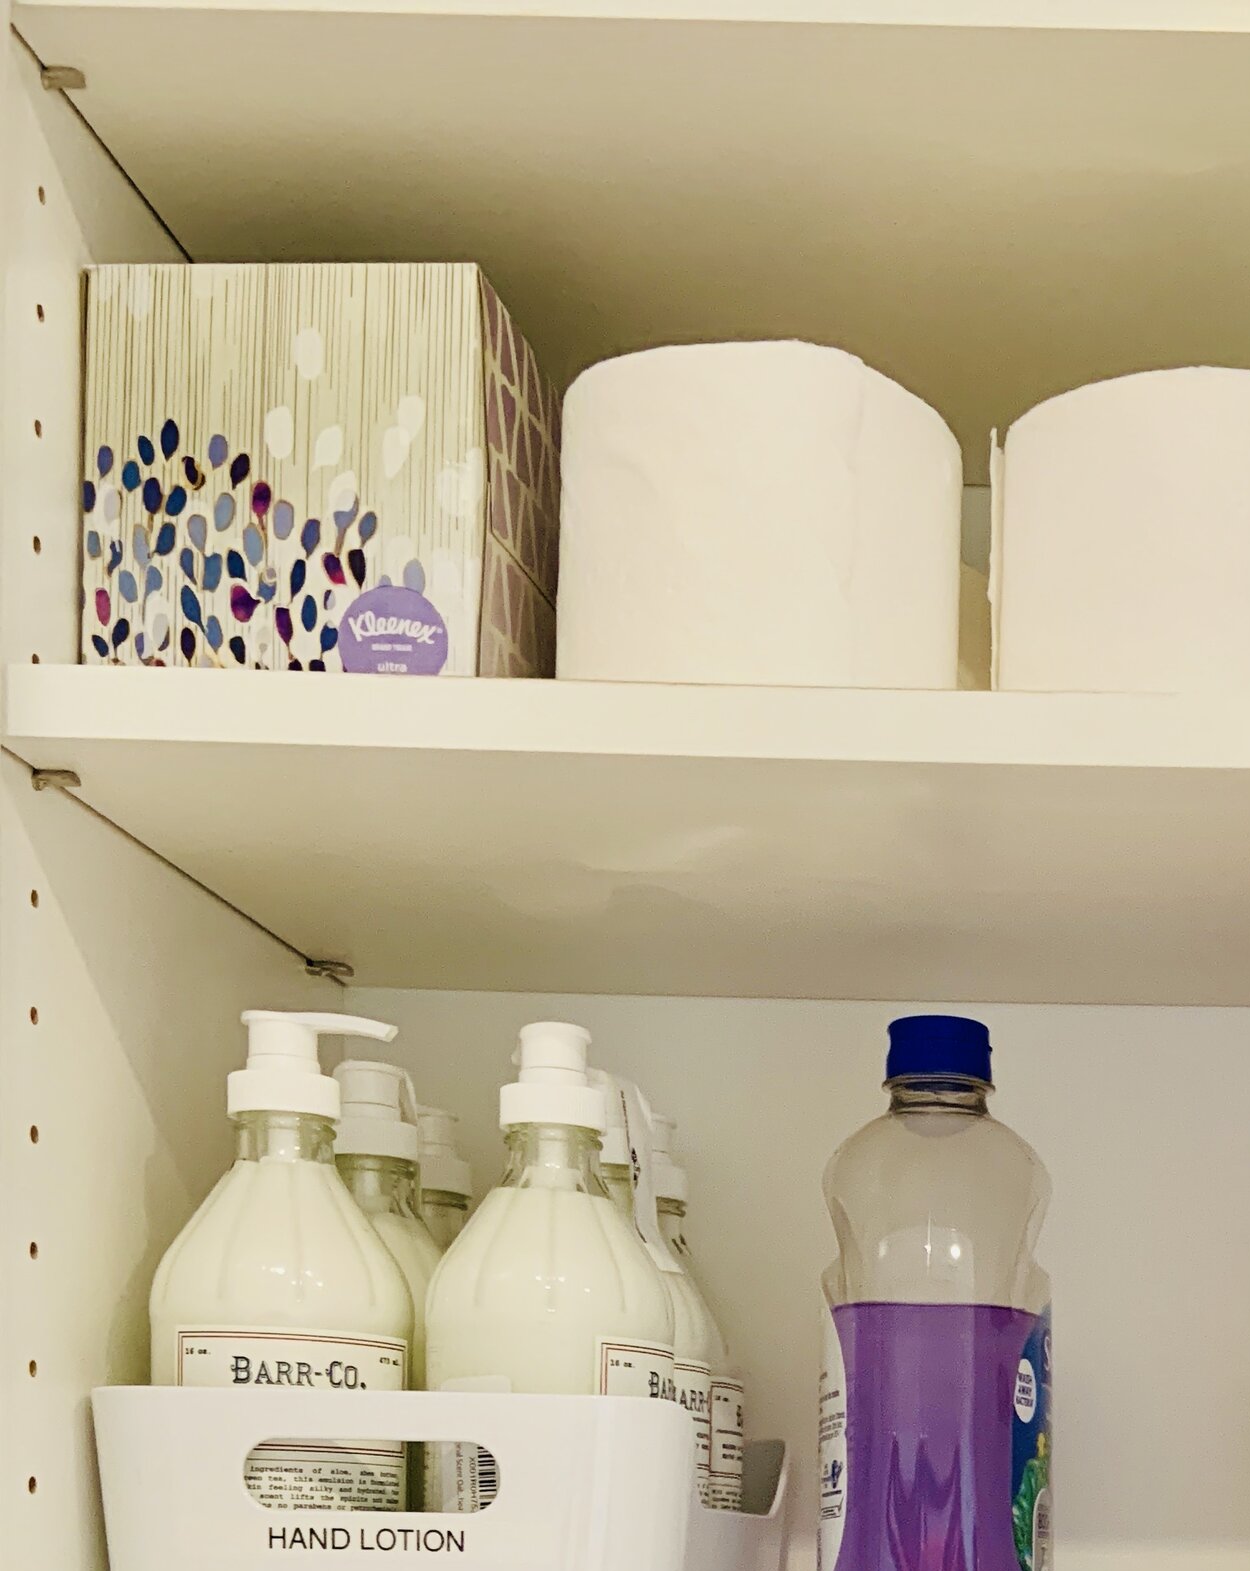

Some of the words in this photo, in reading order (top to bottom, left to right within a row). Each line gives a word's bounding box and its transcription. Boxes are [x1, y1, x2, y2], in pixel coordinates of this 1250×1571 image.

[348, 610, 435, 645] Kleenex
[377, 661, 408, 673] ultra
[250, 1466, 303, 1474] ingredients
[269, 1484, 303, 1492] feeling
[268, 1527, 351, 1550] HAND
[360, 1528, 465, 1552] LOTION
